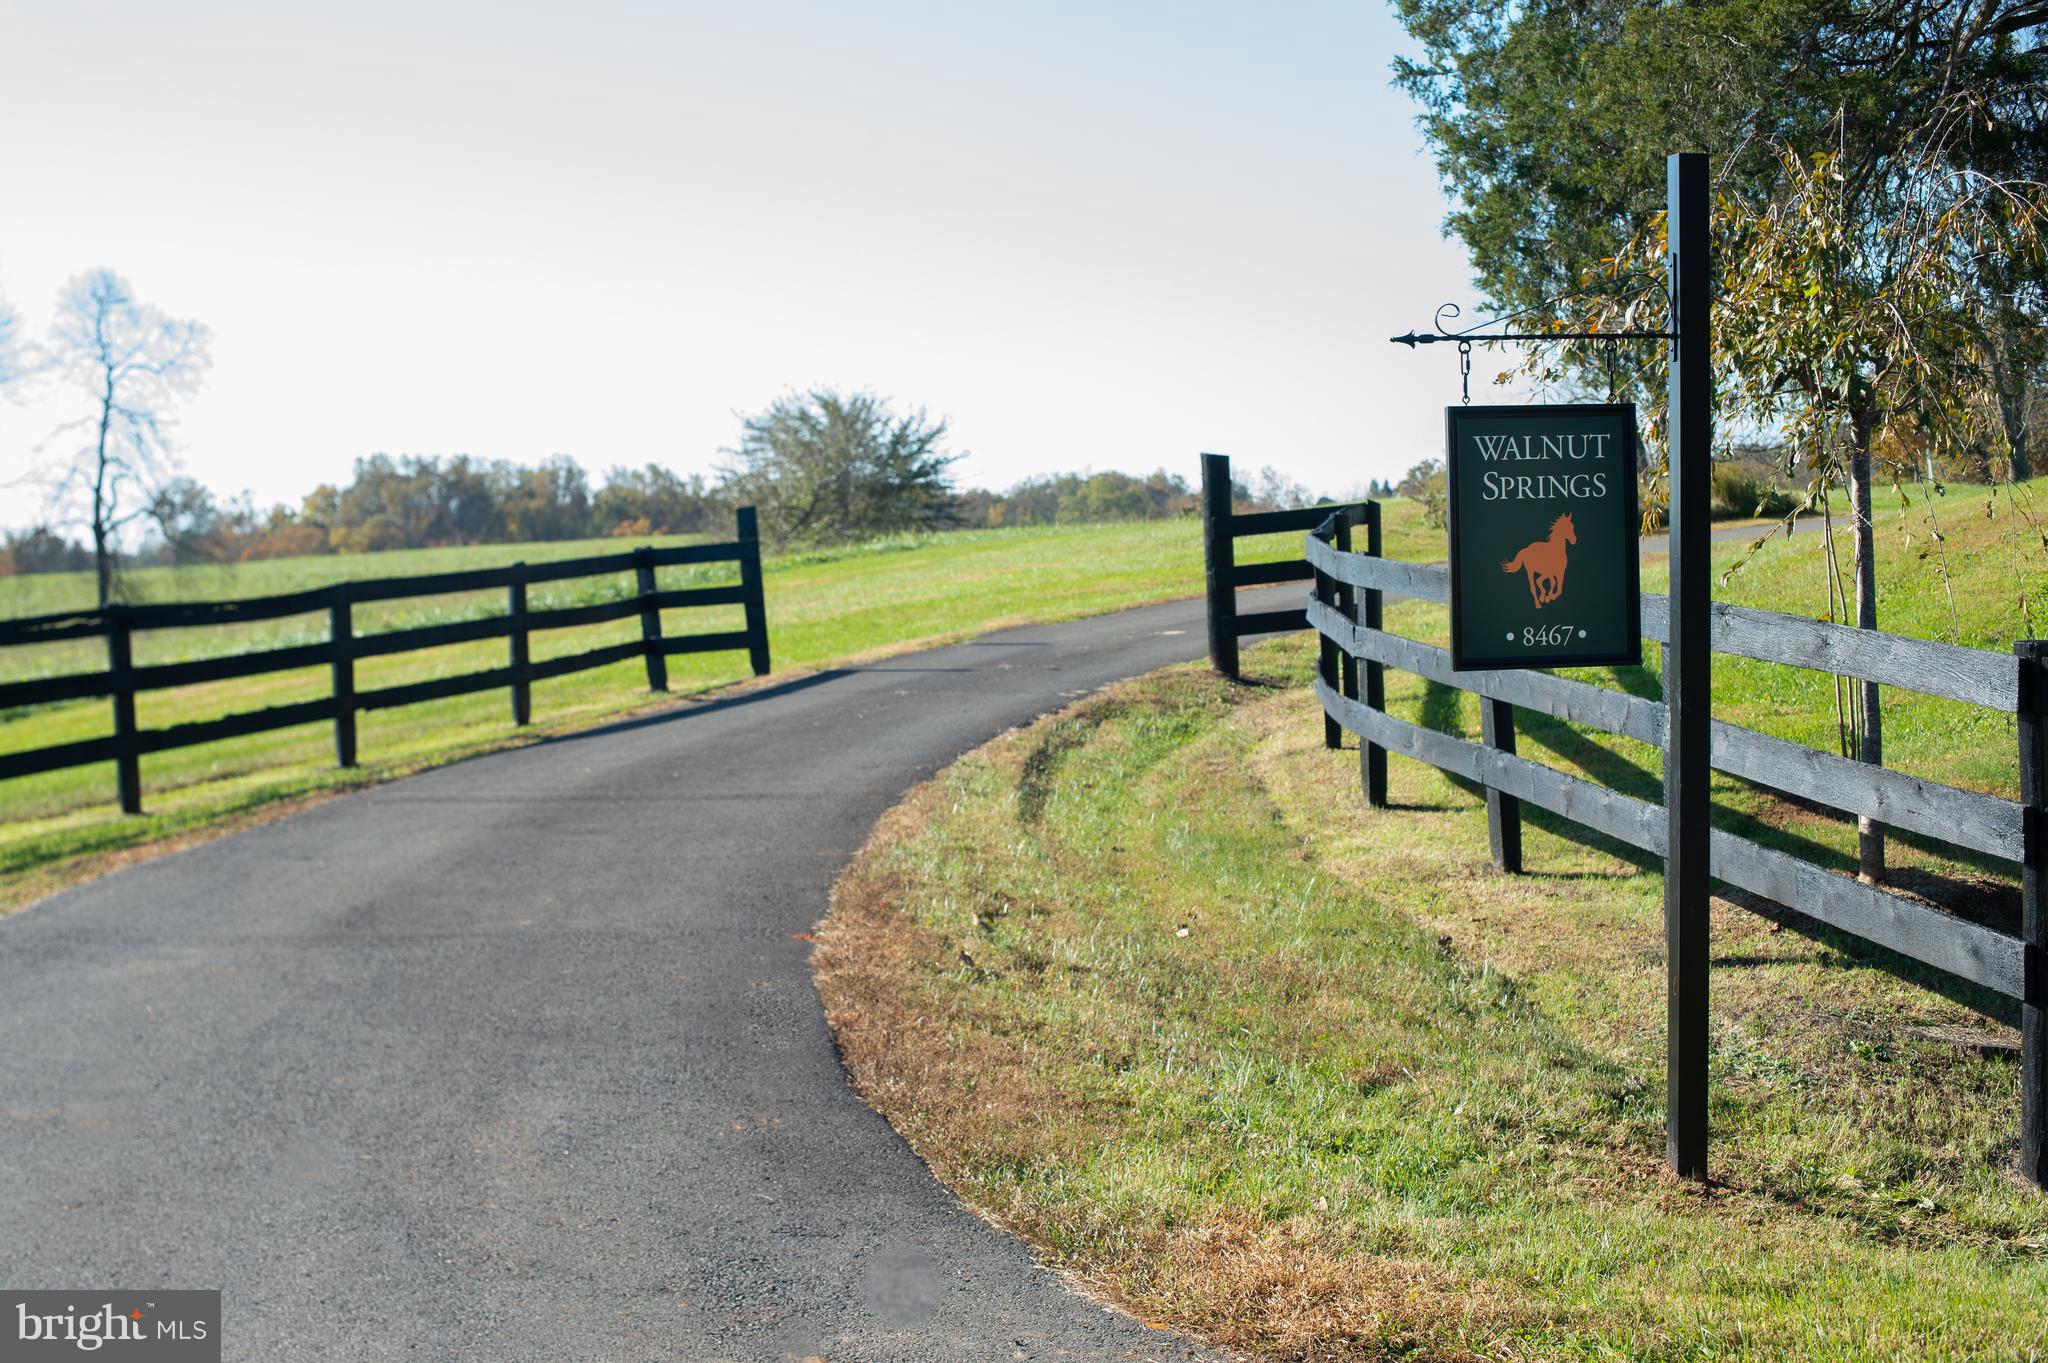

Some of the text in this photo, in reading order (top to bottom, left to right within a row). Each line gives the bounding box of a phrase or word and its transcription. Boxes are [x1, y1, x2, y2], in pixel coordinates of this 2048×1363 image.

[1473, 433, 1611, 461] WALNUT
[1482, 471, 1607, 501] SPRINGS
[1523, 624, 1574, 647] 8467
